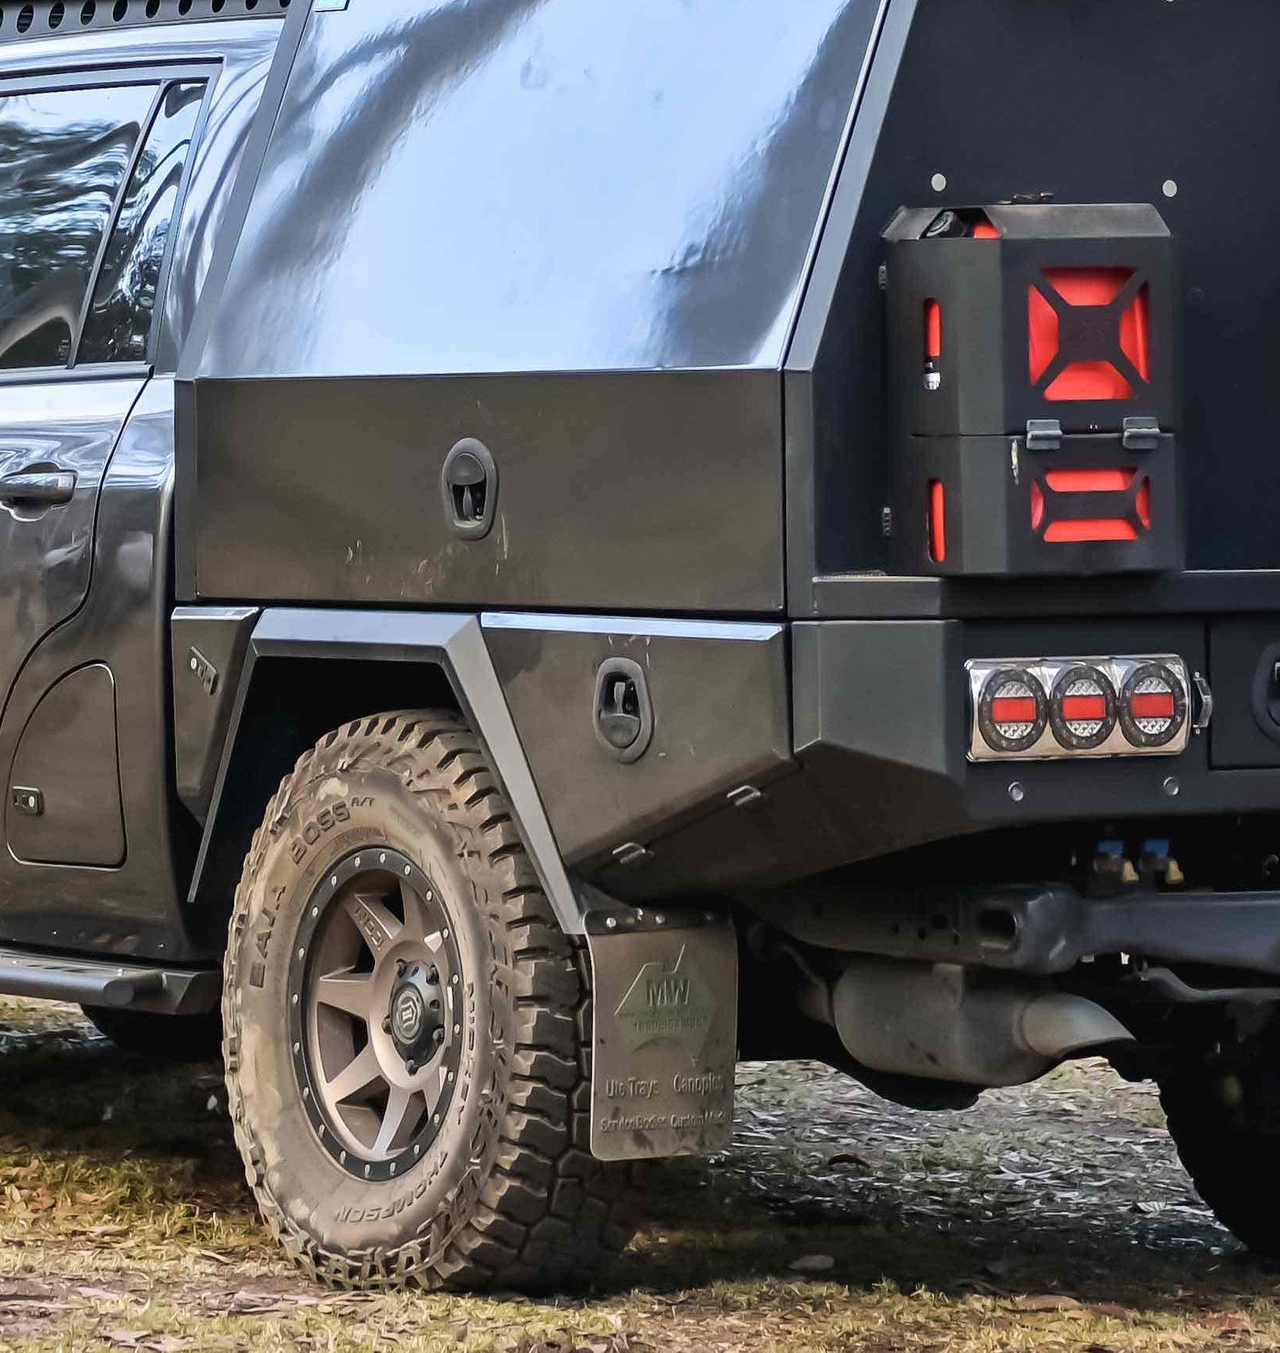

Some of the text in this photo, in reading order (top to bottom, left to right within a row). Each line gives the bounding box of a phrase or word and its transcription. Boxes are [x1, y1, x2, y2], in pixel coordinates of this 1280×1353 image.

[291, 800, 351, 864] BOSS
[646, 979, 691, 1007] MW
[627, 1077, 659, 1099] Trays
